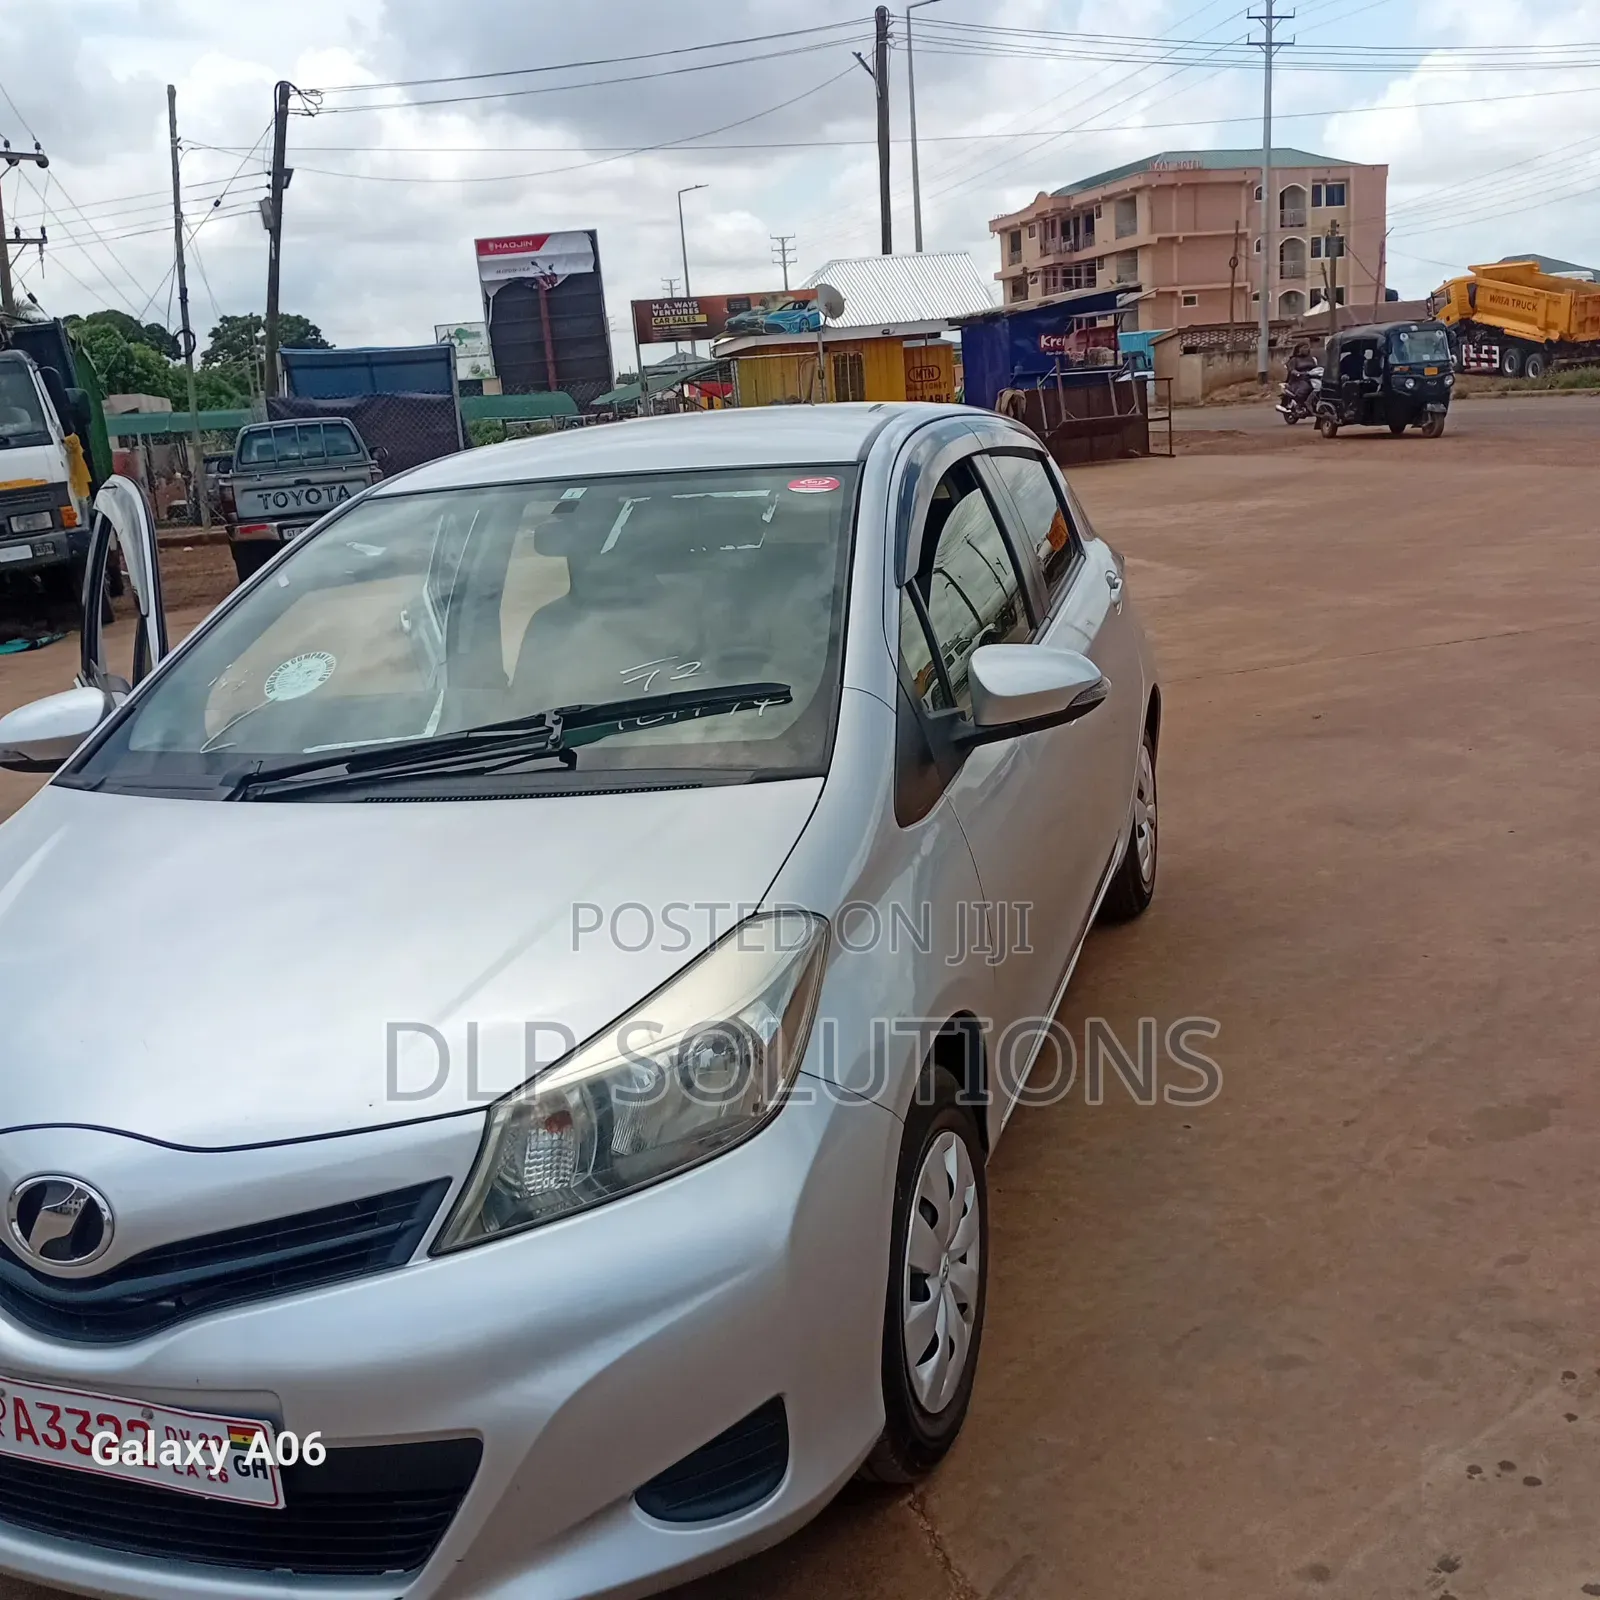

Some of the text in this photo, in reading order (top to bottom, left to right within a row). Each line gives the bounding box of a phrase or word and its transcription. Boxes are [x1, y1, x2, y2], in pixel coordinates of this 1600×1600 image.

[494, 240, 533, 250] HAOJIN
[674, 301, 698, 309] WAYS
[1511, 298, 1538, 311] TRUCK
[652, 308, 700, 317] VENTURES
[653, 315, 697, 325] CAR SALES
[915, 367, 935, 380] MTN
[257, 484, 353, 510] TOYOTA
